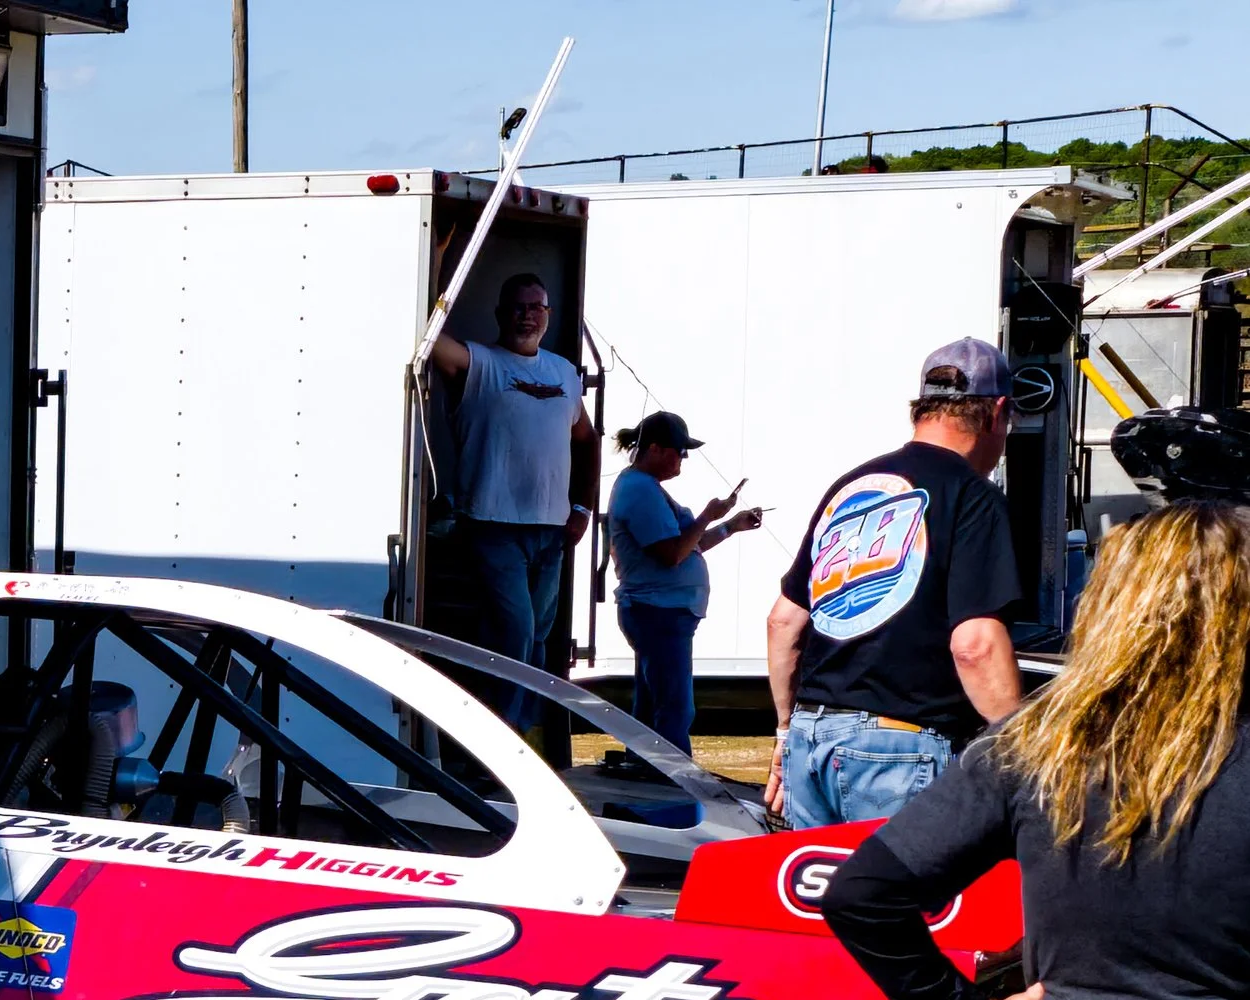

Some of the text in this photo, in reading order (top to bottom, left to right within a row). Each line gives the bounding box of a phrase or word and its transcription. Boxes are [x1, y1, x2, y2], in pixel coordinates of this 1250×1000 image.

[811, 497, 922, 607] 28
[244, 846, 465, 887] HIGGINS
[9, 971, 65, 991] FUELS
